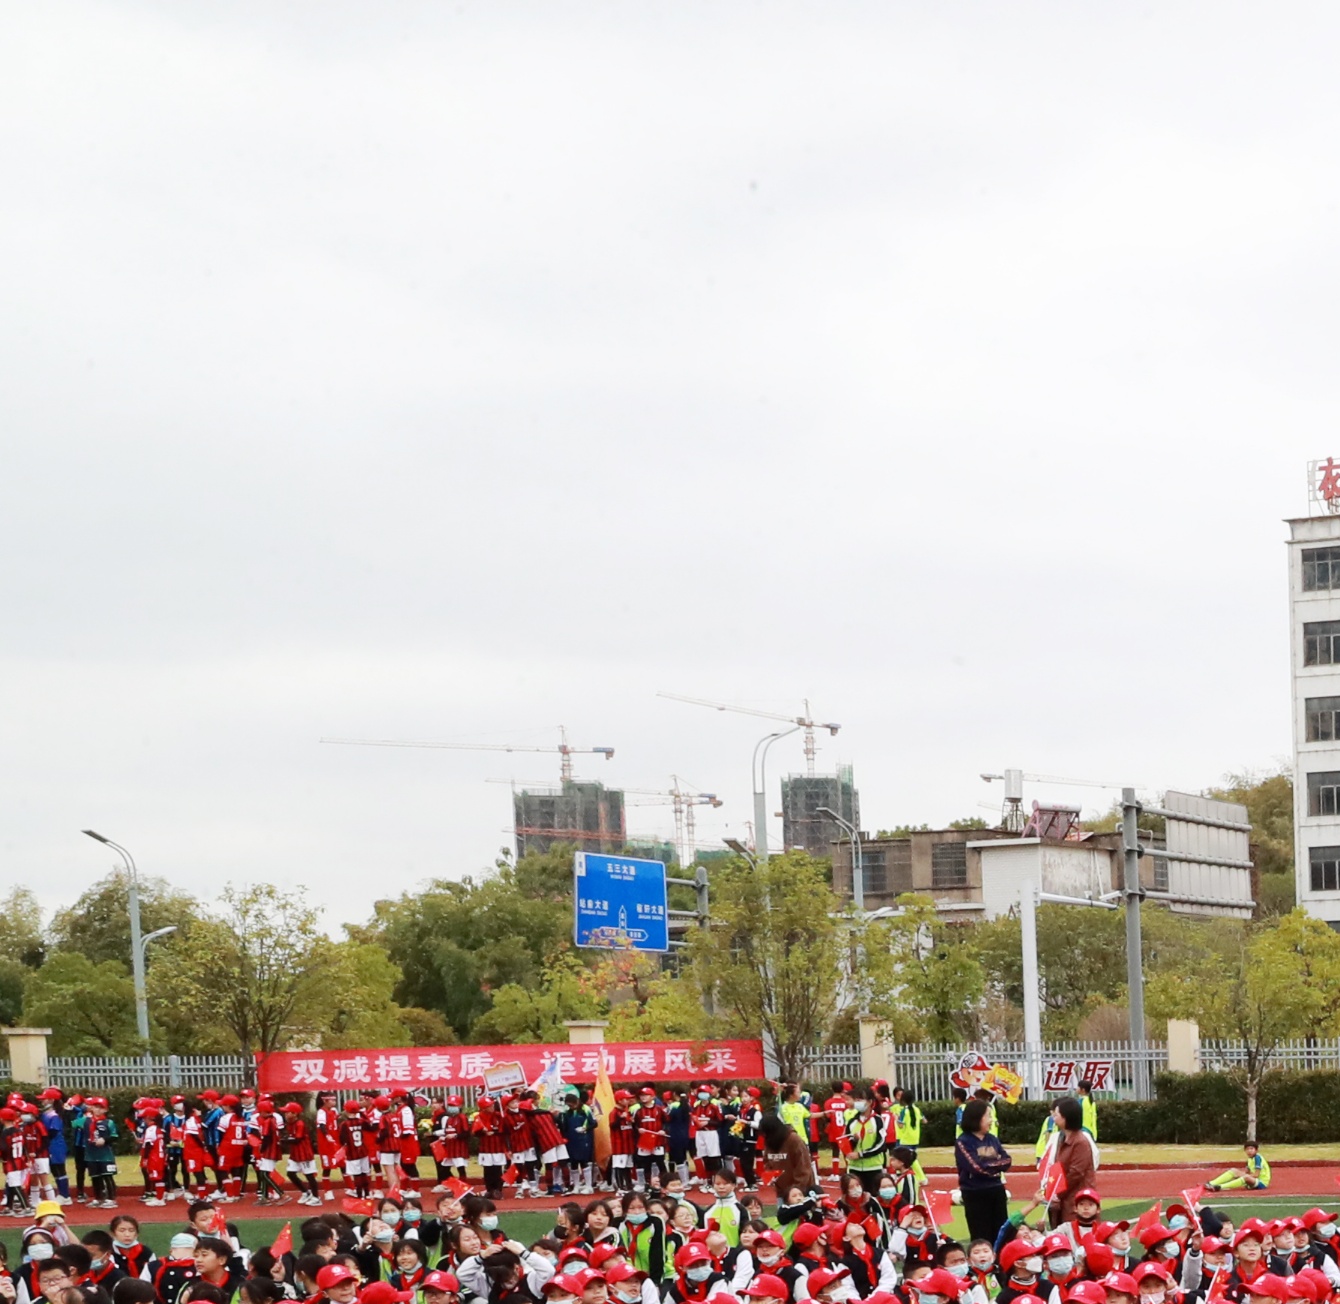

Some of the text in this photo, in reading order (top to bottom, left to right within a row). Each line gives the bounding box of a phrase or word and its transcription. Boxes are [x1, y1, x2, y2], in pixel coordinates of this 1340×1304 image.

[291, 1048, 737, 1084] 双减提素质 运动展风采
[1043, 1060, 1114, 1091] 进取
[352, 1131, 362, 1147] 9
